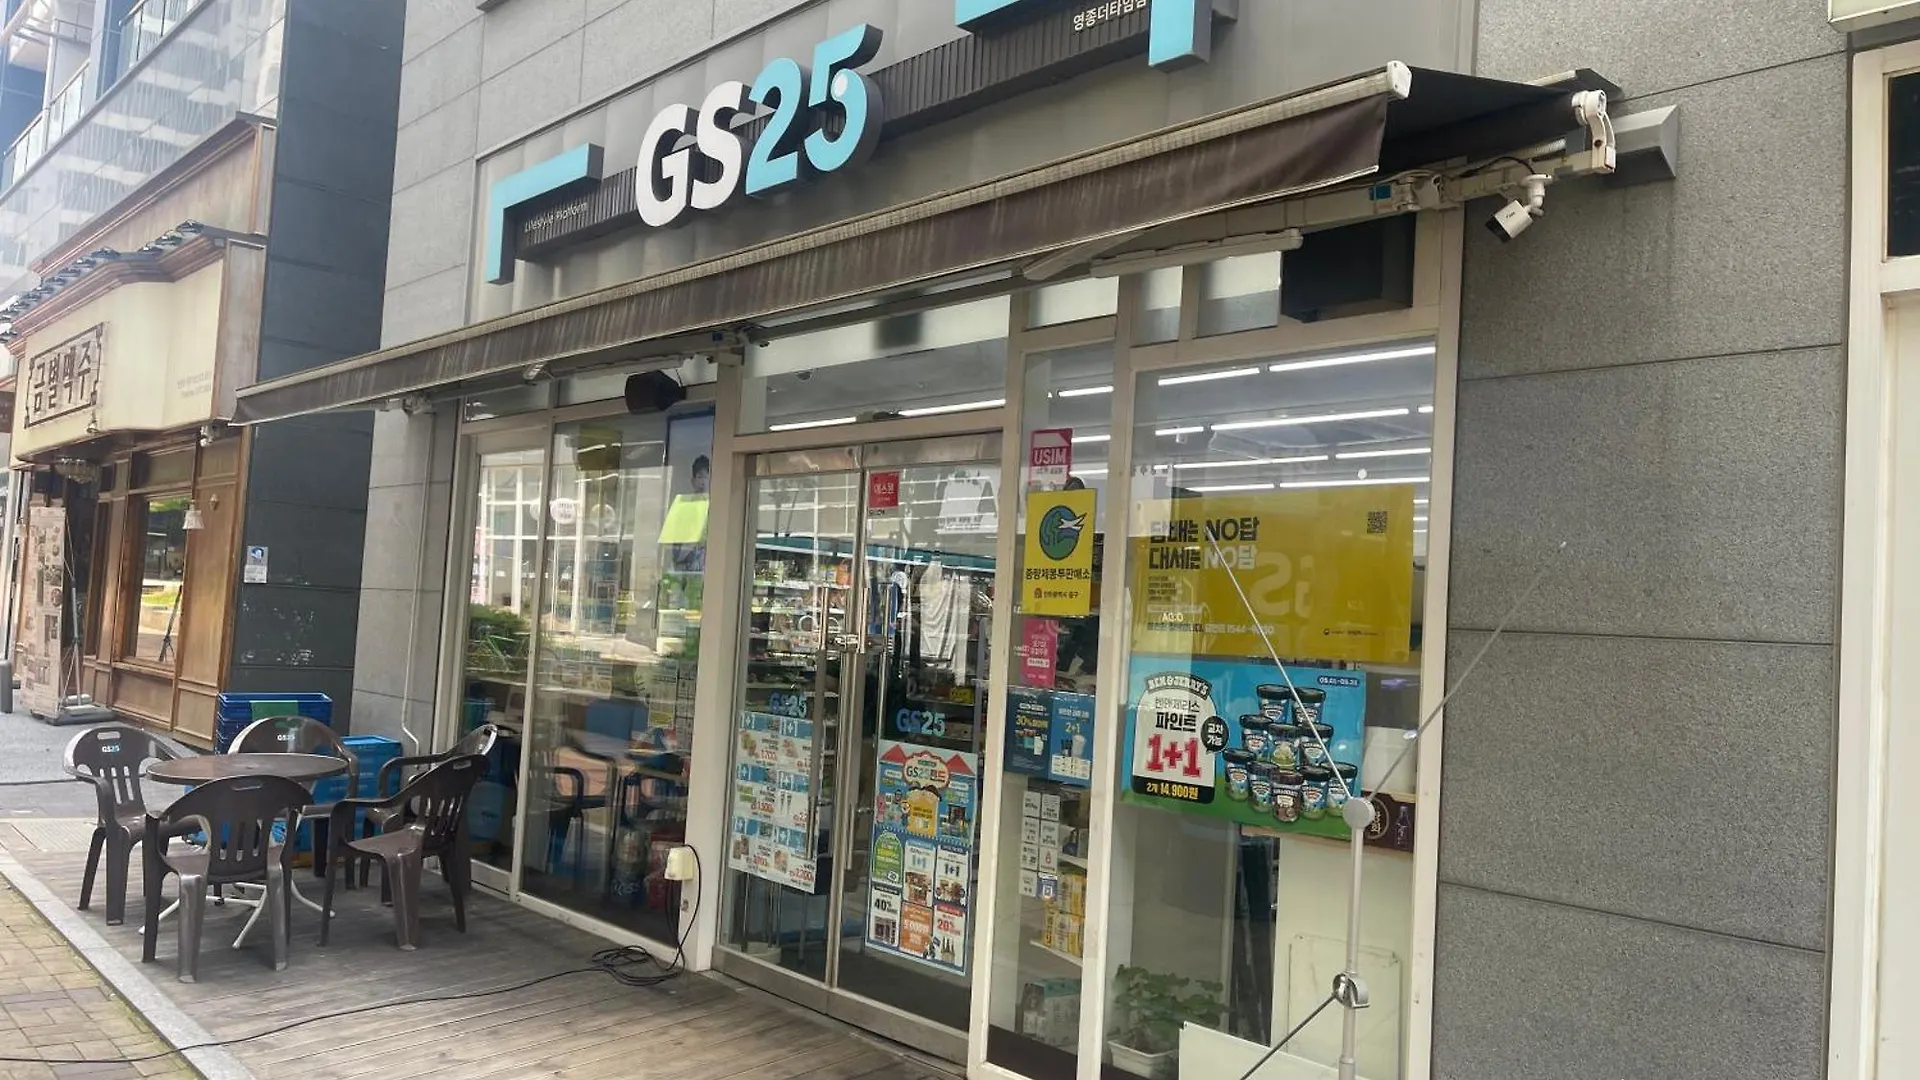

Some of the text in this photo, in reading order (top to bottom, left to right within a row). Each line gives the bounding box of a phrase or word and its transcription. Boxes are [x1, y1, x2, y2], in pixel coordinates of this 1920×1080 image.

[635, 23, 867, 227] GS25
[1033, 449, 1066, 464] USIM
[769, 693, 807, 719] GS25
[896, 708, 945, 738] GS25
[1155, 711, 1197, 733] 파인트
[1146, 733, 1202, 777] 1+1
